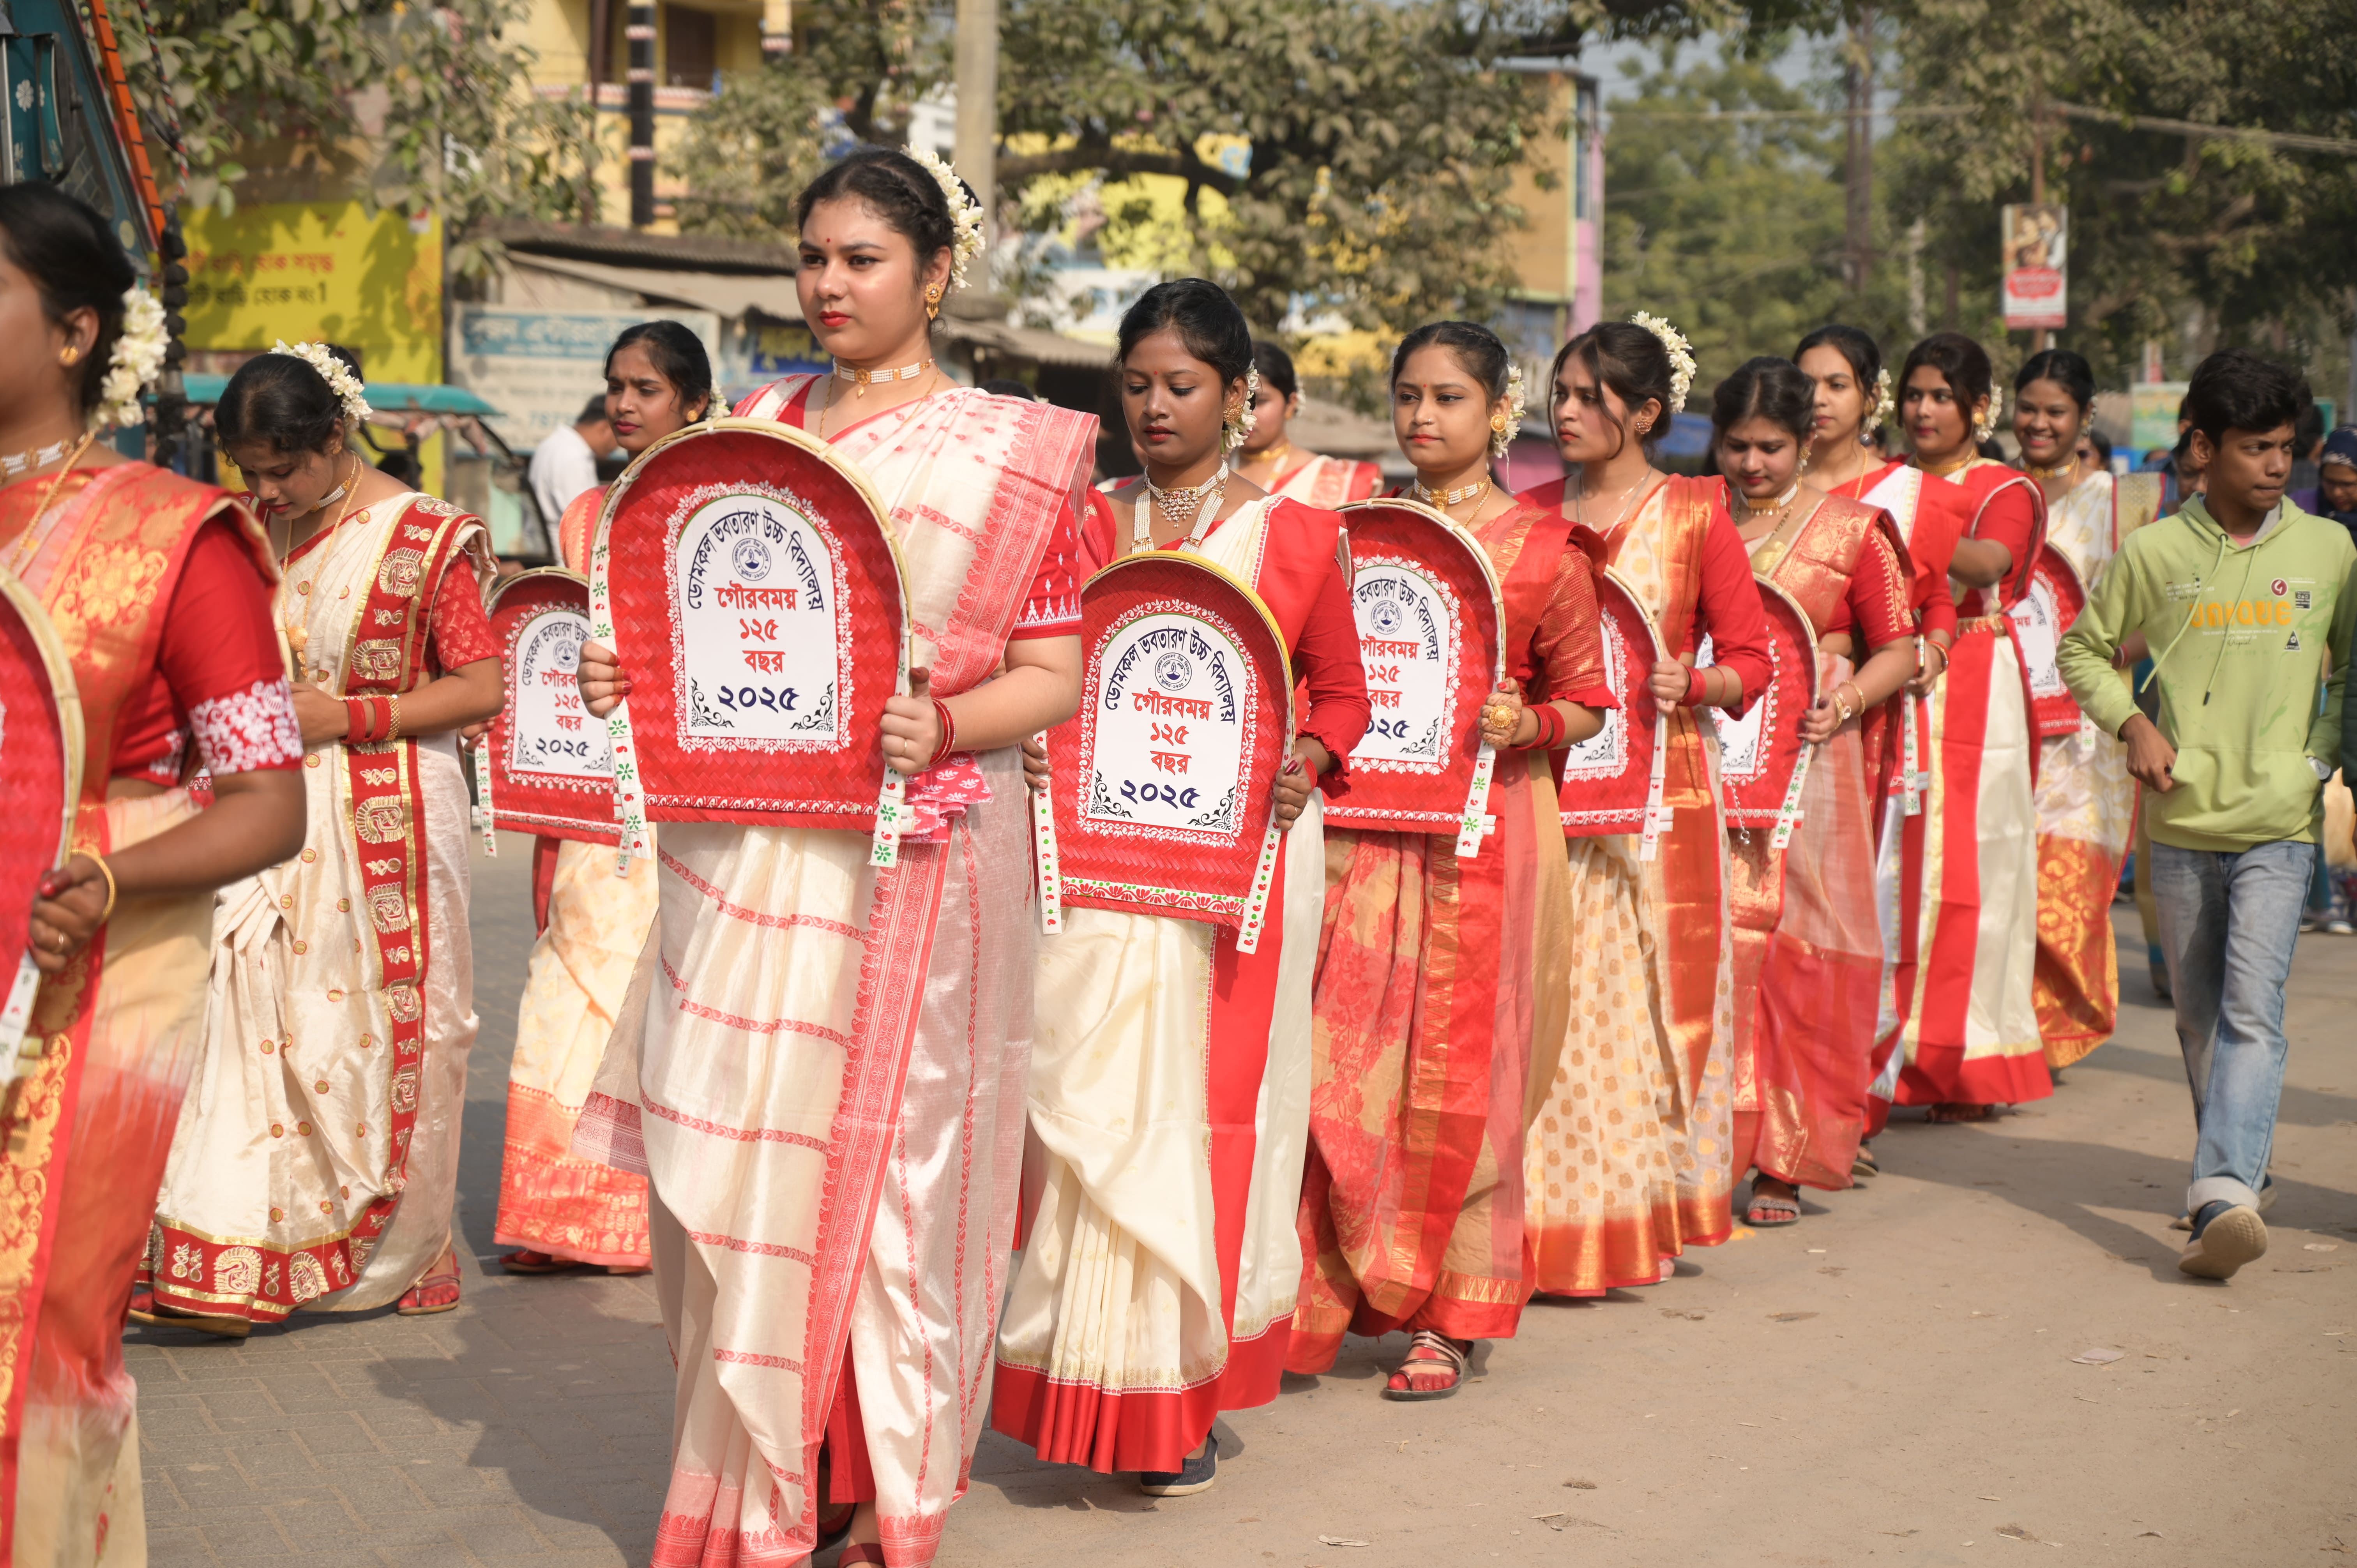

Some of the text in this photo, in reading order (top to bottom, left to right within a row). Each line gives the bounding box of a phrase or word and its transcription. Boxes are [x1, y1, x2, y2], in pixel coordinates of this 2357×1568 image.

[688, 533, 717, 609] ডোমকল
[710, 507, 759, 542] ভবতারণ
[763, 506, 787, 544] উচ্চ
[785, 530, 824, 613] বিদ্যালয়
[713, 580, 799, 611] গৌরবময়
[739, 618, 779, 643] ১২৫
[1356, 576, 1397, 603] ভবতারণ
[1399, 576, 1418, 607] উচ্চ
[1413, 596, 1439, 662] বিদ্যালয়
[522, 635, 544, 686] ডোমকল
[540, 620, 572, 642] ভবতারণ
[742, 650, 786, 675] বছর
[540, 667, 577, 688] গৌরব
[1105, 625, 1236, 725] ডোমকল ভবতারণ উচ্চ বিদ্যালয়
[1368, 664, 1401, 684] ১২৫
[555, 692, 580, 710] ১২৫
[717, 685, 800, 713] ২০২৫
[1131, 687, 1214, 721] গৌরবময়
[1368, 689, 1403, 710] বছর
[555, 715, 583, 731] বছর
[1150, 722, 1189, 746] ১২৫
[535, 738, 590, 758] ২০২৫
[1150, 750, 1192, 775] বছর
[1120, 780, 1201, 809] ২০২৫
